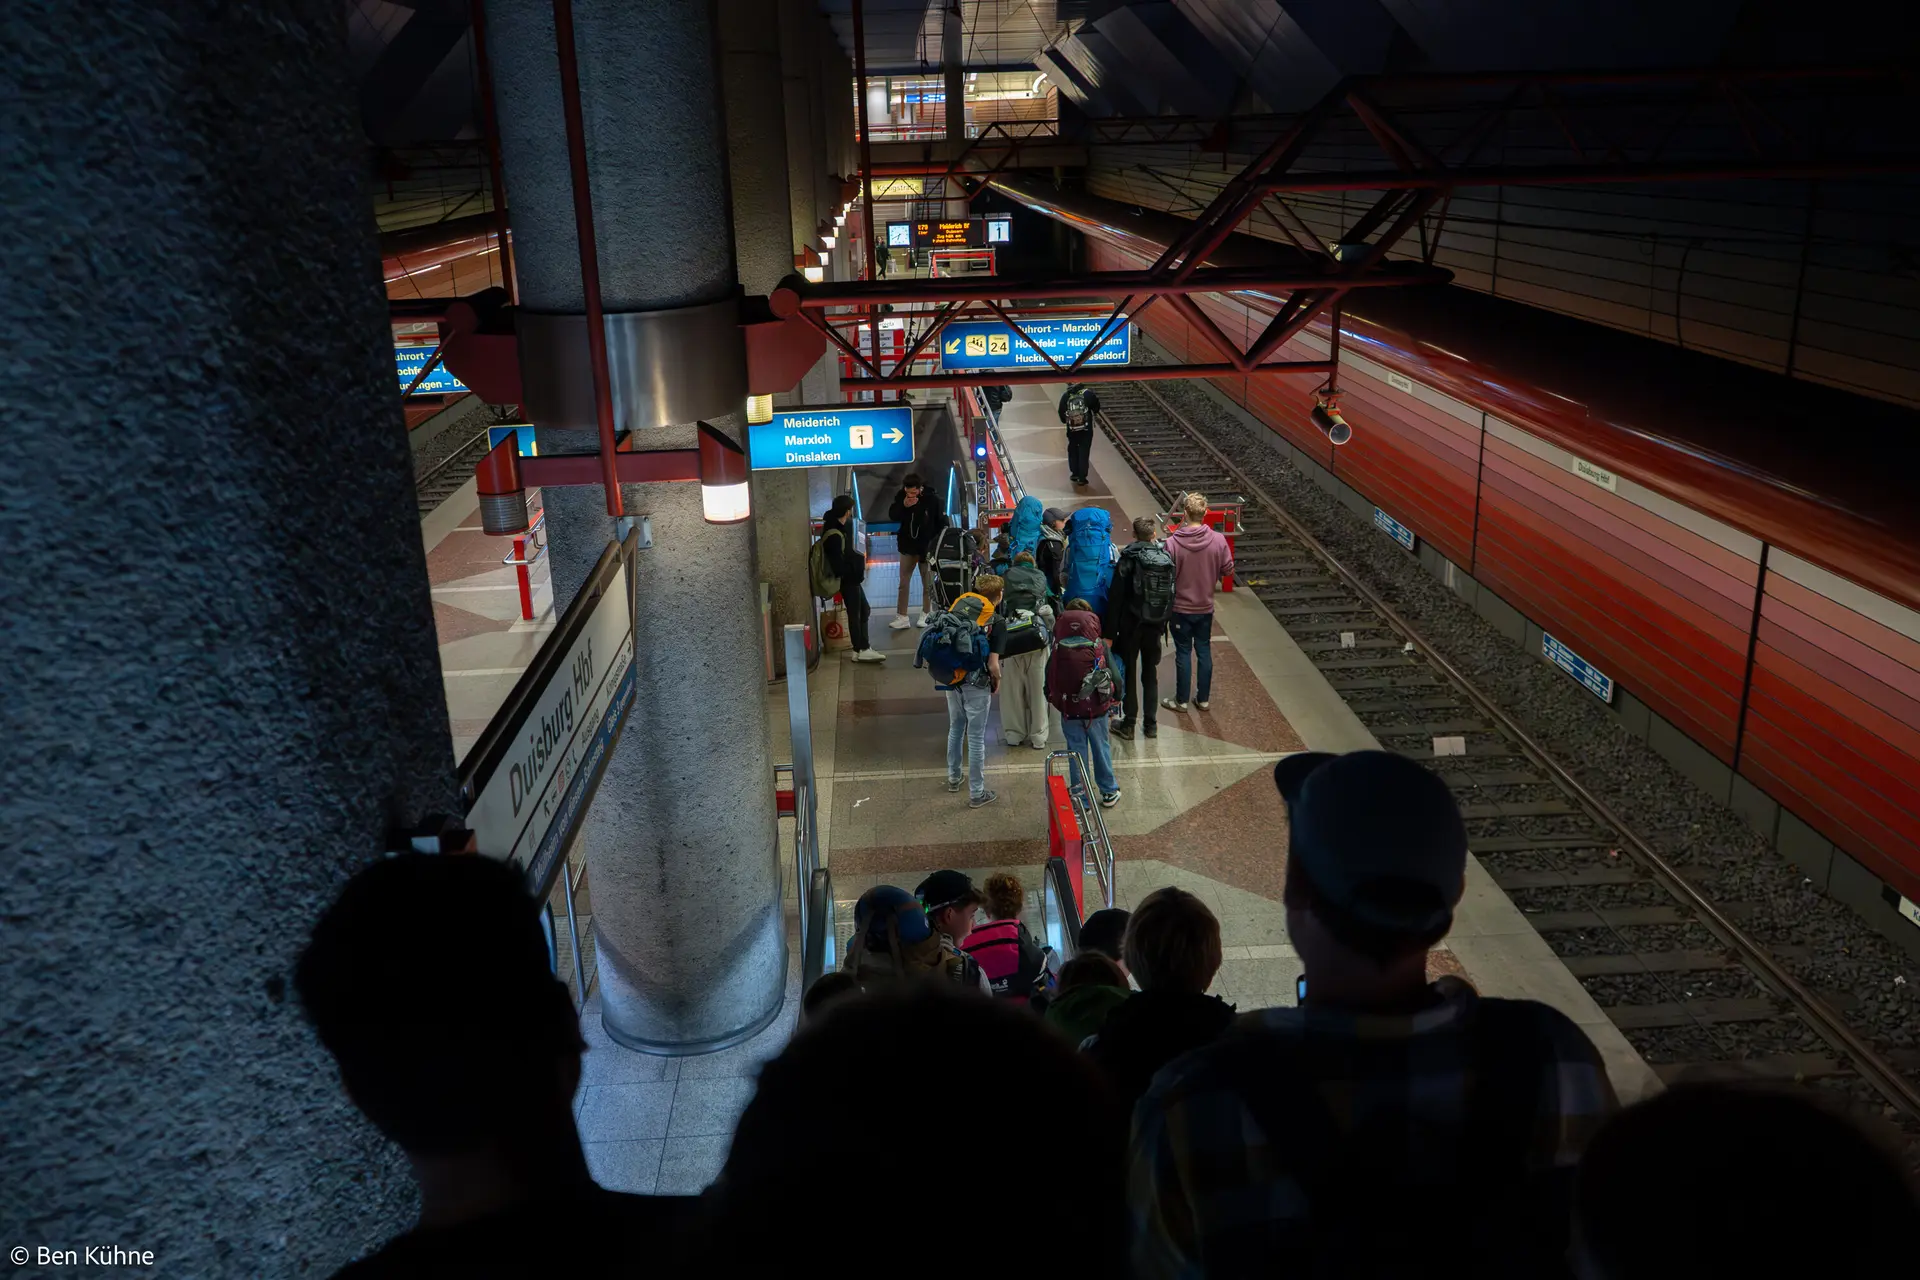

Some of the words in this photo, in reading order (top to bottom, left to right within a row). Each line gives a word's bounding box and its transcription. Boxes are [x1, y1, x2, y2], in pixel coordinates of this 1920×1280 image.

[996, 227, 1002, 239] 1
[1062, 322, 1101, 333] Marxloh
[395, 352, 425, 361] uhrort
[783, 416, 841, 429] Meiderich
[785, 433, 832, 446] Marxloh
[857, 434, 864, 445] 1
[786, 451, 841, 463] Dinslaken
[509, 687, 574, 818] Duisburg
[573, 636, 594, 705] Hbf
